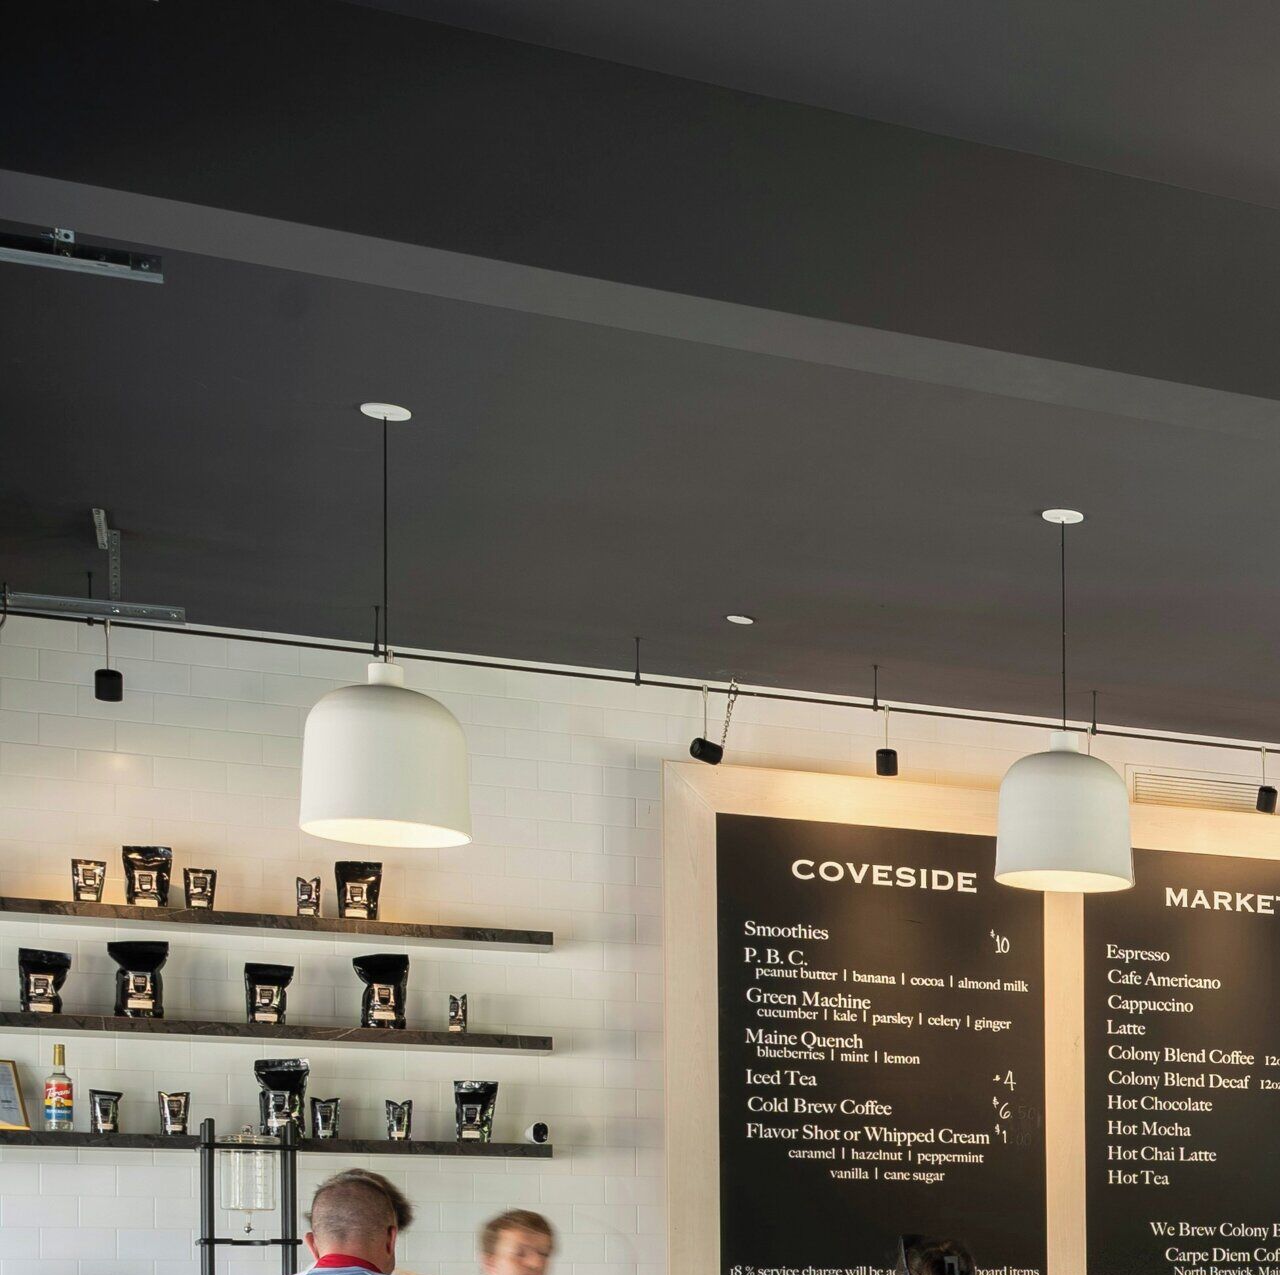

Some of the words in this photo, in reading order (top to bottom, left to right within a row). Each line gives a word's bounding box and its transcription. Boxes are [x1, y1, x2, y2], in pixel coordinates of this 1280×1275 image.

[791, 859, 977, 893] COVESIDE
[744, 921, 829, 941] Smoothies
[1106, 944, 1170, 964] Espresso
[755, 967, 798, 980] peanut
[800, 967, 838, 981] butter
[852, 971, 896, 985] banana
[910, 975, 944, 987] cocoa
[958, 978, 1001, 991] almond
[1003, 980, 1029, 993] milk
[1107, 969, 1141, 985] Cafe
[1144, 972, 1221, 990] Americano
[746, 987, 797, 1006] Green
[801, 991, 871, 1010] Machine
[1107, 995, 1194, 1014] Cappuccino
[756, 1008, 819, 1020] cucumber
[833, 1009, 858, 1023] kale
[872, 1013, 914, 1028] parsley
[928, 1014, 962, 1030] celery
[974, 1018, 1012, 1031] ginger
[1107, 1020, 1146, 1035] Latte
[744, 1028, 797, 1046] Maine
[801, 1031, 864, 1050] Quench
[756, 1047, 825, 1061] blueberries
[841, 1051, 869, 1063] mint
[884, 1052, 920, 1065] lemon
[1108, 1045, 1161, 1065] Colony
[1164, 1047, 1206, 1063] Blend
[1209, 1049, 1255, 1065] Coffee
[746, 1069, 781, 1085] Iced
[784, 1071, 817, 1087] Tea
[1108, 1070, 1161, 1091] Colony
[1164, 1072, 1205, 1088] Blend
[1209, 1074, 1251, 1089] Decaf
[747, 1097, 788, 1113] Cold
[793, 1099, 837, 1114] Brew
[840, 1099, 893, 1116] Coffee
[1107, 1095, 1138, 1111] Hot
[1141, 1096, 1213, 1112] Chocolate
[746, 1123, 799, 1141] Flavor
[802, 1125, 841, 1142] Shot
[843, 1130, 861, 1142] or
[864, 1126, 935, 1146] Whipped
[938, 1128, 990, 1145] Cream
[1107, 1121, 1138, 1136] Hot
[1142, 1122, 1191, 1137] Mocha
[788, 1148, 836, 1160] caramel
[851, 1149, 903, 1162] hazelnut
[917, 1151, 984, 1165] peppermint
[1107, 1145, 1138, 1161] Hot
[1141, 1146, 1175, 1161] Chai
[1179, 1147, 1217, 1162] Latte
[829, 1168, 869, 1180] vanilla
[884, 1170, 910, 1181] cane
[912, 1171, 946, 1184] sugar
[1108, 1170, 1138, 1185] Hot
[1141, 1171, 1170, 1185] Tea
[1150, 1222, 1175, 1237] We
[1178, 1224, 1217, 1237] Brew
[1219, 1224, 1269, 1241] Colony
[1165, 1248, 1209, 1265] Carpe
[1212, 1248, 1250, 1262] Diem
